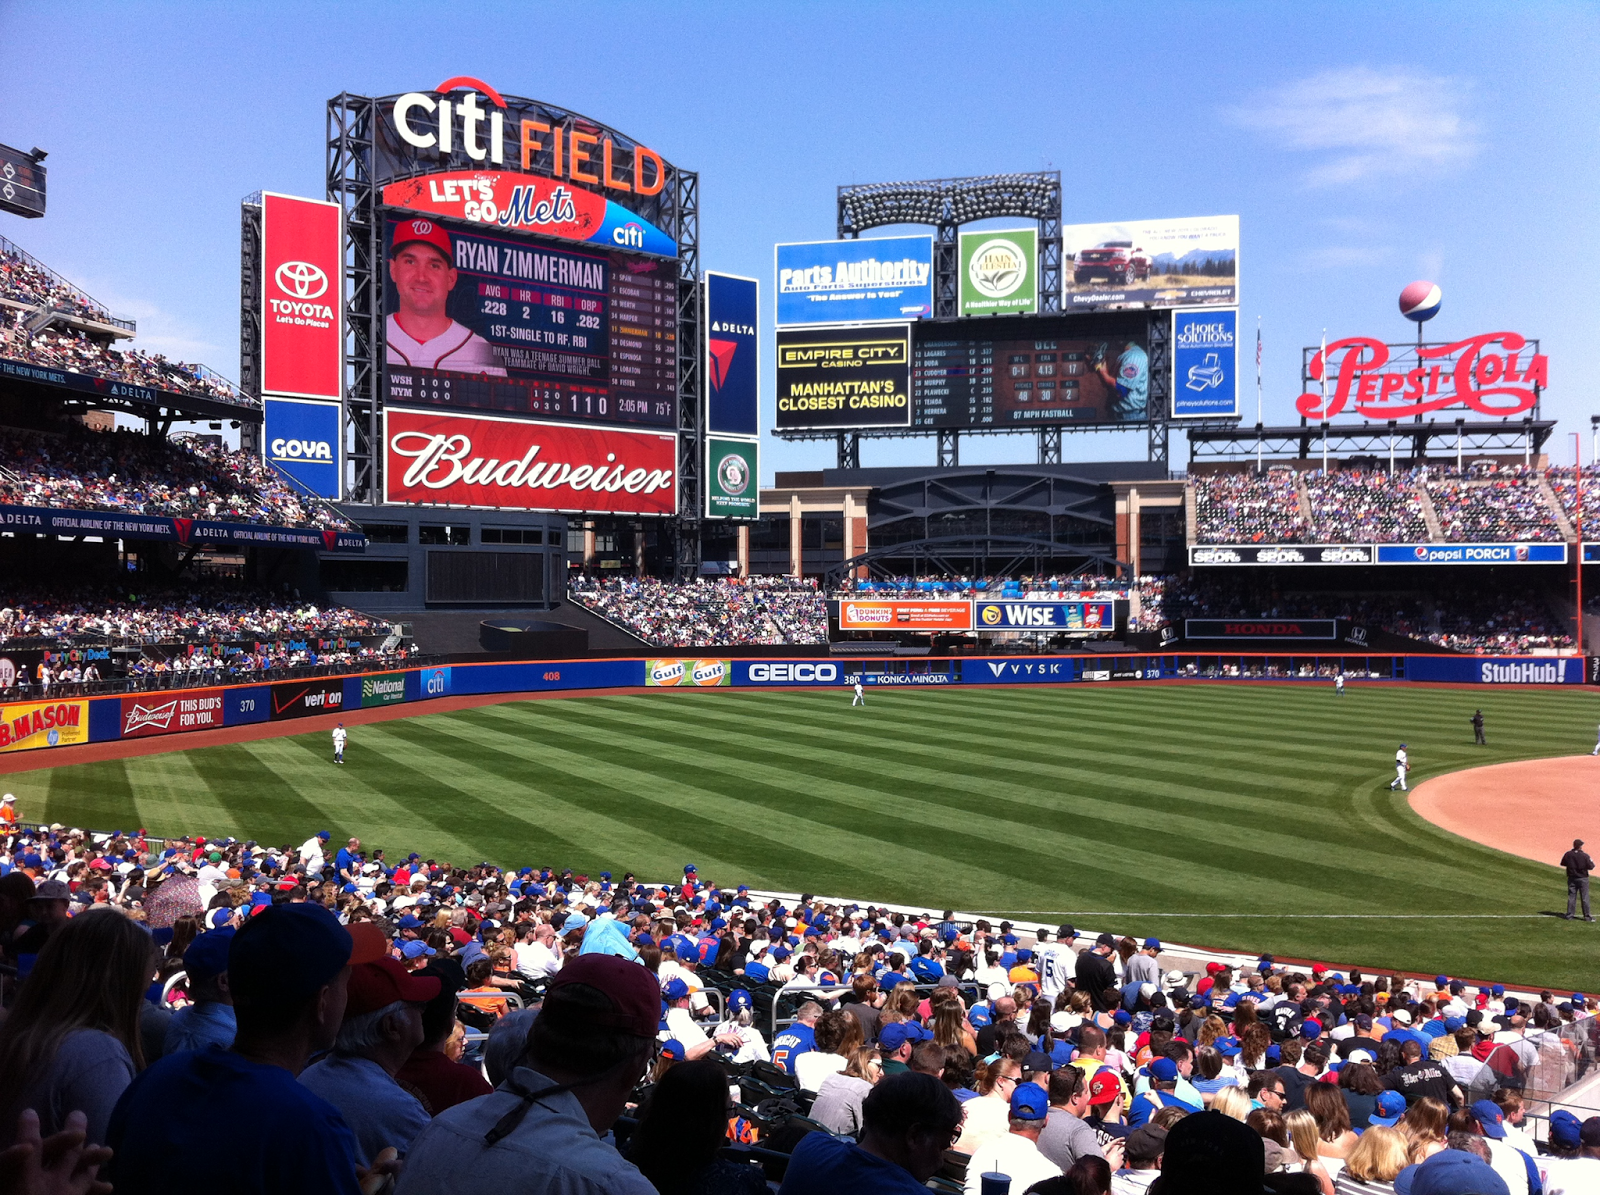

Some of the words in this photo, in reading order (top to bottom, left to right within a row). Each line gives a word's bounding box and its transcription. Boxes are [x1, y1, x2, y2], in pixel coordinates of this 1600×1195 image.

[393, 92, 504, 164] citi
[520, 118, 665, 196] FIELD
[429, 179, 494, 202] LET'S
[464, 201, 498, 223] GO
[498, 185, 576, 227] Mets
[613, 225, 643, 248] citi
[456, 239, 498, 274] RYAN
[503, 248, 603, 290] ZIMMERMAN
[985, 254, 1012, 263] HAIN
[780, 265, 833, 286] Parts
[835, 258, 930, 284] Authority
[485, 285, 501, 298] AVG
[520, 290, 531, 303] HR
[551, 295, 565, 307] RBI
[581, 300, 597, 312] OBP
[269, 299, 334, 319] TOYOTA
[481, 301, 507, 316] .228
[522, 306, 531, 319] 2
[551, 310, 565, 324] 16
[576, 315, 600, 330] .282
[276, 314, 294, 325] Let's
[294, 317, 305, 326] Go
[305, 318, 329, 328] Places
[722, 322, 755, 336] DELTA
[1184, 322, 1225, 334] CHOICE
[490, 325, 542, 342] 1ST-SINGLE
[544, 331, 555, 344] TO
[573, 335, 587, 348] RBI
[1177, 332, 1233, 343] SOLUTIONS
[492, 346, 509, 358] RYAN
[510, 348, 525, 360] WAS
[525, 349, 530, 360] A
[531, 351, 558, 363] TEENAGE
[558, 354, 587, 366] SUMMER
[587, 357, 601, 369] BALL
[785, 348, 854, 361] EMPIRE
[3, 362, 15, 374] THE
[15, 366, 31, 377] NEW
[31, 369, 48, 380] YORK
[504, 357, 538, 370] TEAMMATE
[538, 360, 546, 371] OF
[548, 362, 566, 373] DAVID
[821, 359, 863, 368] CASINO
[1069, 363, 1077, 374] 17
[121, 385, 152, 400] DELTA
[390, 374, 413, 386] WSH
[421, 378, 426, 386] 1
[432, 379, 438, 387] 0
[444, 380, 450, 388] 0
[534, 389, 539, 397] 1
[544, 390, 550, 398] 2
[554, 391, 560, 399] 0
[790, 380, 894, 397] MANHATTAN'S
[390, 386, 413, 397] NYM
[420, 390, 426, 398] 0
[432, 391, 438, 399] 0
[444, 392, 450, 400] 0
[533, 401, 539, 409] 0
[544, 402, 550, 410] 3
[554, 403, 560, 411] 0
[778, 396, 846, 411] CLOSEST
[849, 394, 906, 409] CASINO
[1041, 390, 1051, 401] 30
[571, 394, 577, 412] 1
[586, 396, 591, 413] 1
[599, 397, 607, 415] 0
[619, 399, 636, 412] 2:05
[637, 401, 648, 414] PM
[1023, 410, 1040, 418] MPH
[1041, 409, 1074, 418] FASTBALL
[271, 438, 331, 460] GOYA
[390, 431, 673, 494] Budweiser
[7, 513, 42, 526] DELTA
[52, 516, 79, 528] OFFICIAL
[79, 518, 103, 530] AIRLINE
[103, 520, 112, 530] OF
[113, 520, 124, 531] THE
[124, 521, 138, 532] NEW
[138, 522, 154, 533] YORK
[202, 528, 229, 538] DELTA
[343, 538, 363, 548] DELTA
[1429, 548, 1462, 561] pepsi
[1465, 548, 1510, 560] PORCH
[1005, 604, 1055, 625] WISE
[1223, 624, 1303, 634] HONDA
[542, 671, 560, 681] 408
[653, 665, 684, 681] Gulf
[693, 665, 724, 681] Gulf
[748, 663, 837, 682] GEICO
[1146, 669, 1160, 679] 370
[1481, 659, 1567, 683] StubHub!
[372, 678, 404, 695] National
[427, 677, 444, 694] citi
[844, 675, 860, 684] 380
[877, 675, 911, 684] KONICA
[912, 675, 948, 683] MINOLTA
[180, 699, 197, 712] THIS
[199, 697, 222, 710] BUD'S
[240, 699, 255, 712] 370
[304, 690, 342, 708] verizon
[126, 709, 175, 724] Budweiser
[180, 713, 195, 726] FOR
[196, 712, 214, 724] YOU.
[1046, 958, 1054, 978] 5
